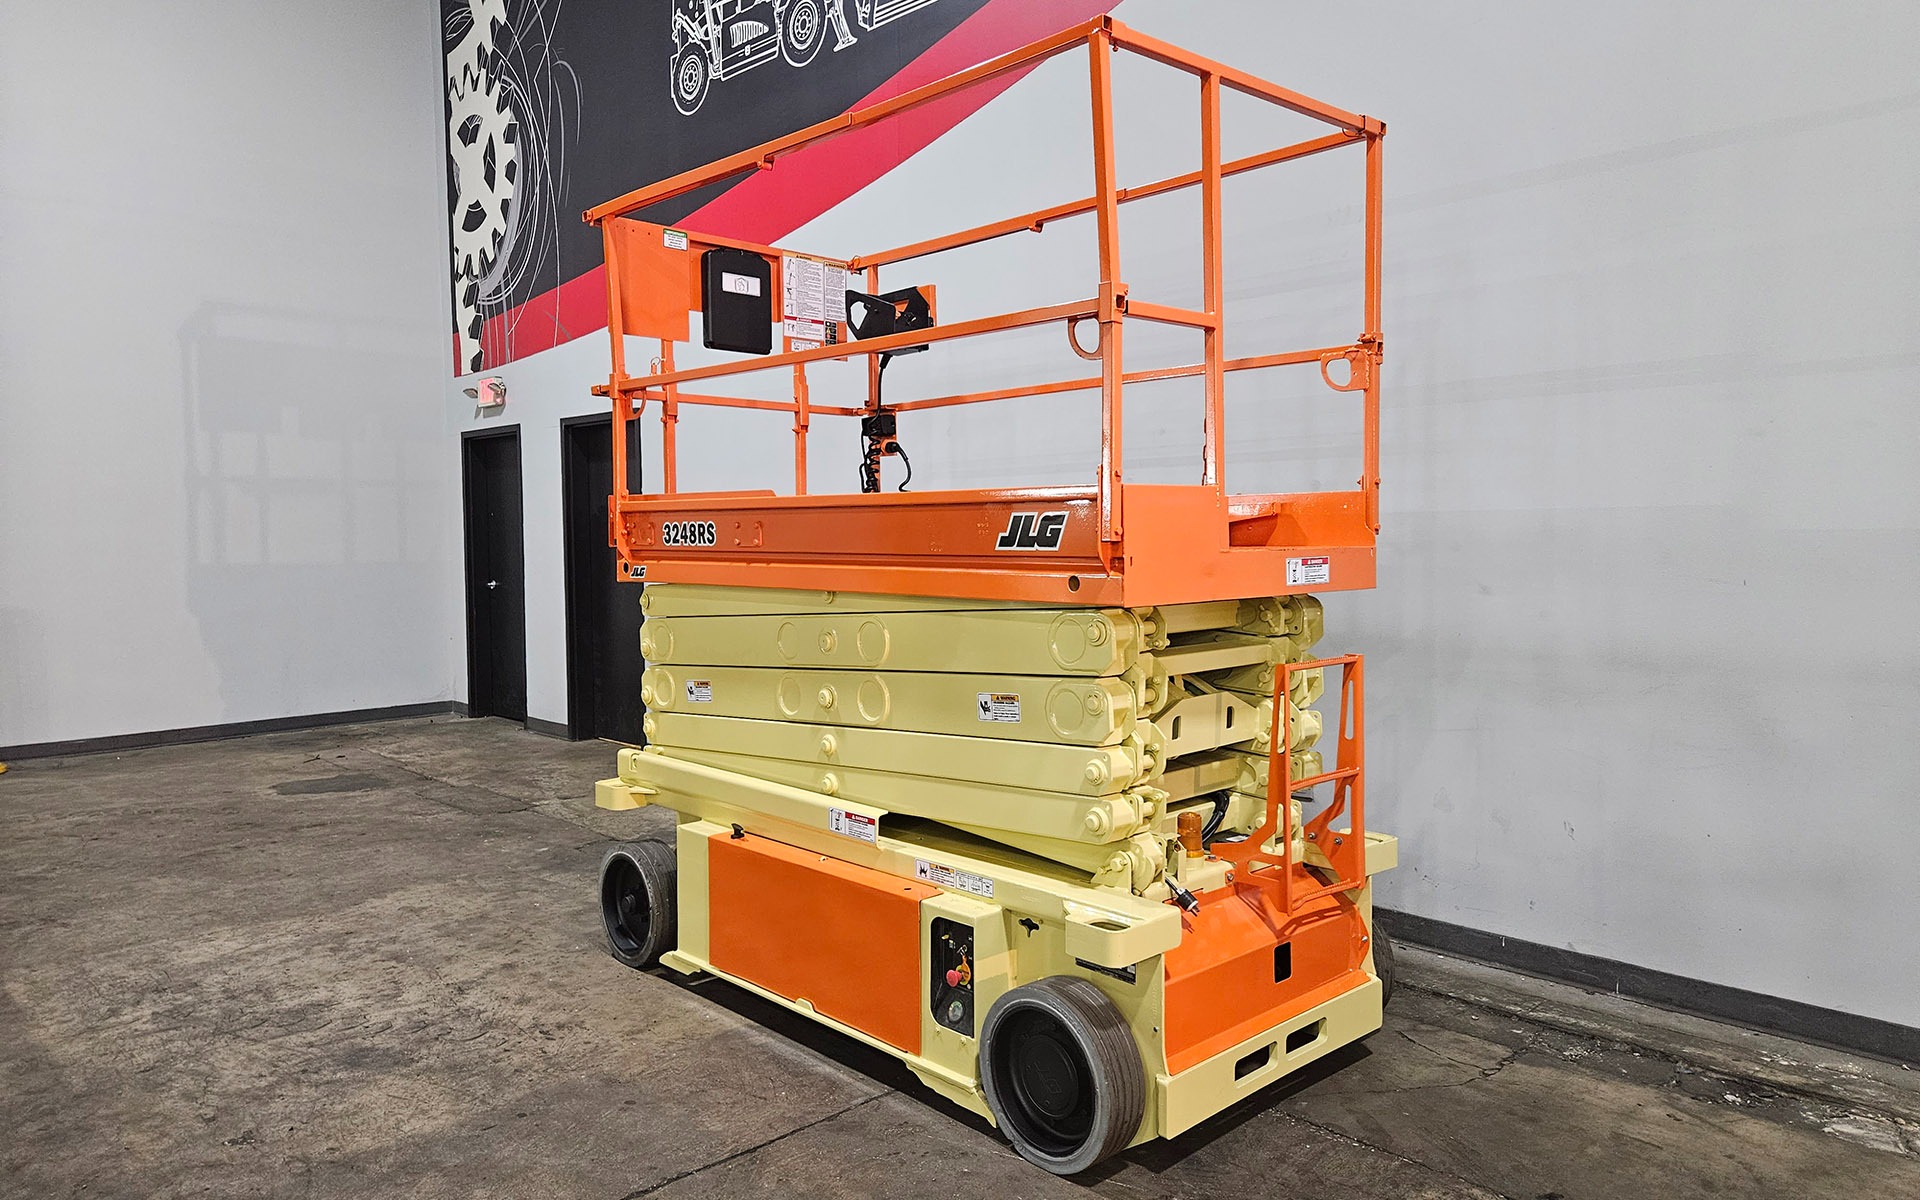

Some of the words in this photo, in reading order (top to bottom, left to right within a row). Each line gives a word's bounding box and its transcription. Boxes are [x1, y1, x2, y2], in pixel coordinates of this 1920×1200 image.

[663, 522, 715, 545] 3248RS
[997, 513, 1067, 548] JLG
[630, 566, 646, 577] JLG
